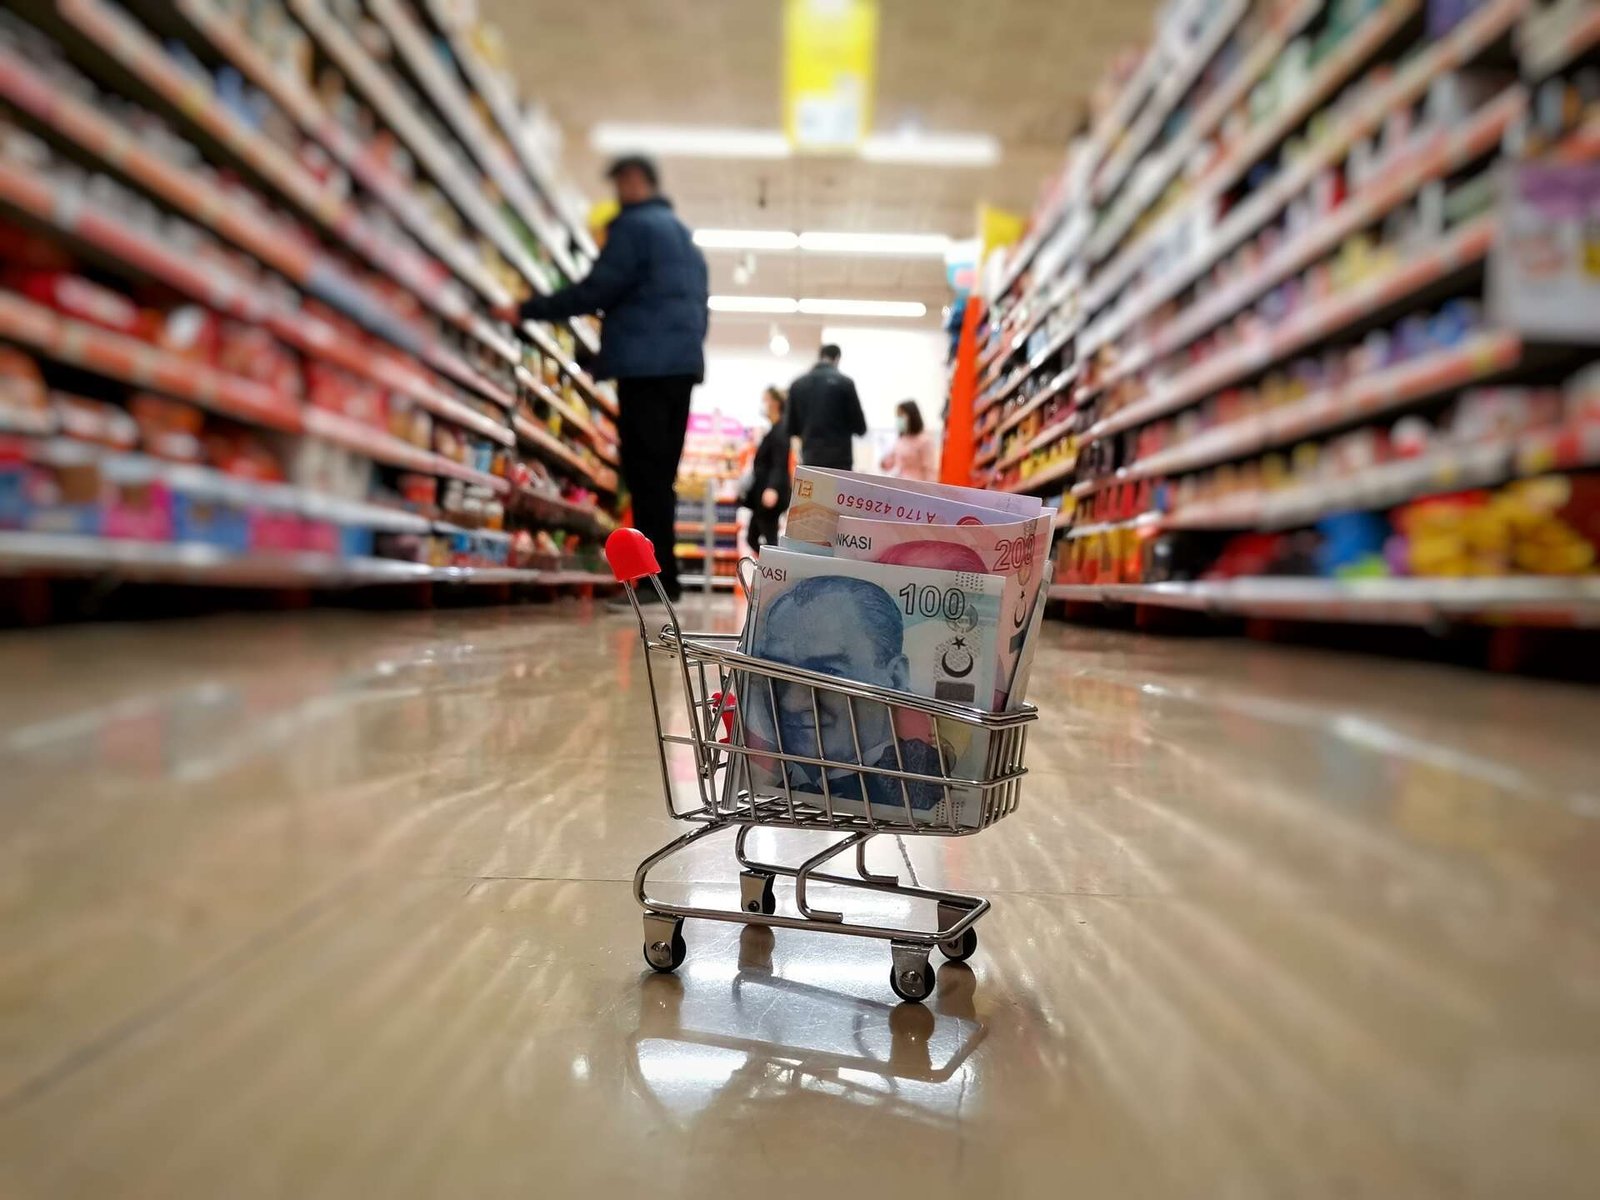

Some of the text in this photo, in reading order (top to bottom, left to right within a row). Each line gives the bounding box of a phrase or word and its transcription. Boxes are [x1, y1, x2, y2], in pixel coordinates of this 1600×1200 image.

[837, 493, 936, 523] A 170 426550
[993, 534, 1036, 571] 200
[899, 583, 965, 620] 100
